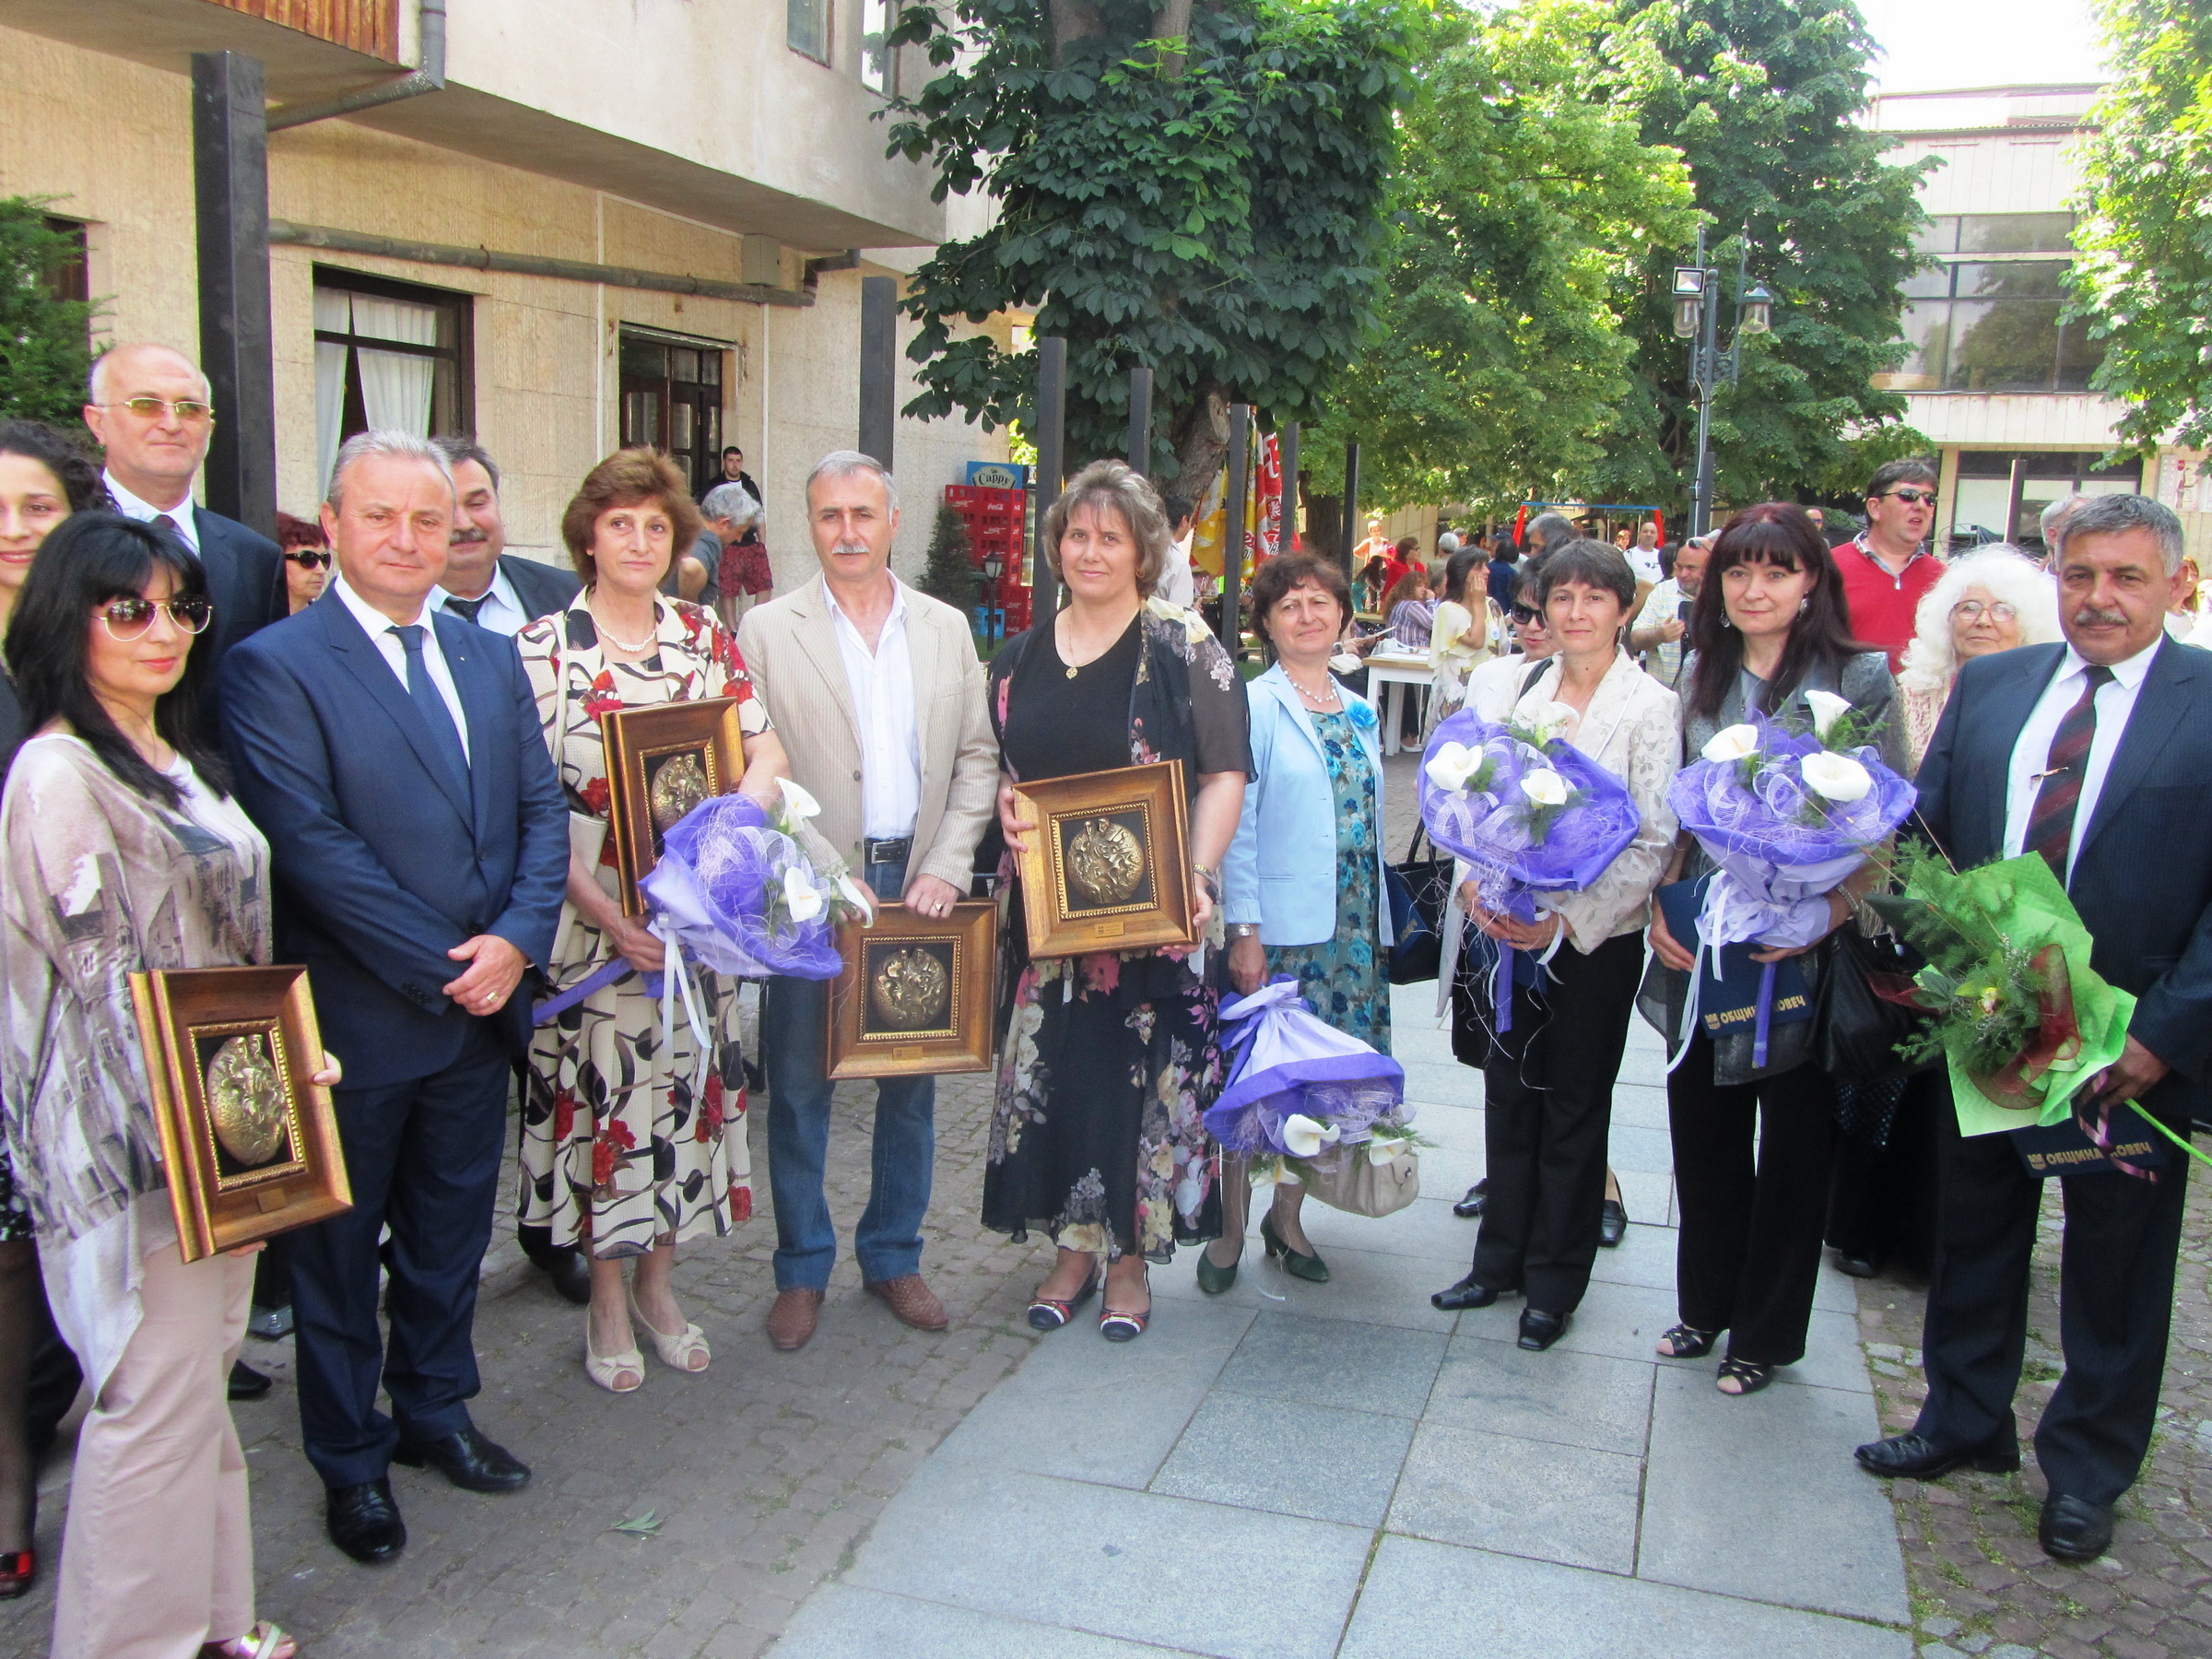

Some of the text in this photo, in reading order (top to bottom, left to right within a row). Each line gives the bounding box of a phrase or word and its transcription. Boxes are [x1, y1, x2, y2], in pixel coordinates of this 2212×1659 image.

[979, 473, 1010, 486] Cappy
[1720, 995, 1806, 1023] ОБЩИН ОВЕЧ
[2045, 1147, 2103, 1164] ОБЩИНА
